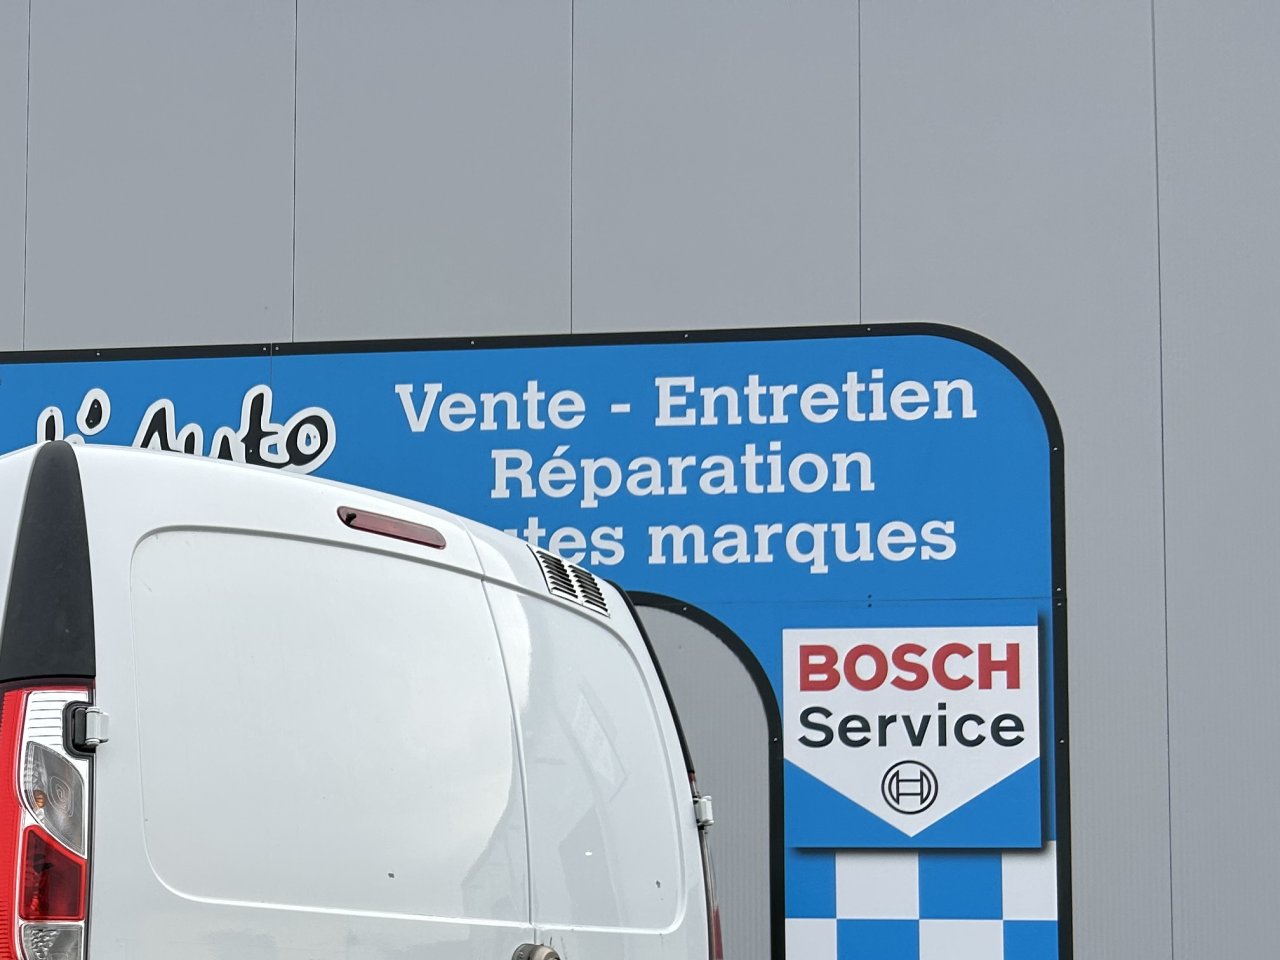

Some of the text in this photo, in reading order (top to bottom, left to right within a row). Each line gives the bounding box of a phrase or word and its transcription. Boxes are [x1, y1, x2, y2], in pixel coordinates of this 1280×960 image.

[395, 381, 585, 432] Vente
[655, 369, 977, 426] Entretien
[491, 444, 875, 508] Réparation
[503, 517, 956, 574] tes marques
[800, 643, 1020, 691] BOSCH
[798, 702, 1025, 748] Service
